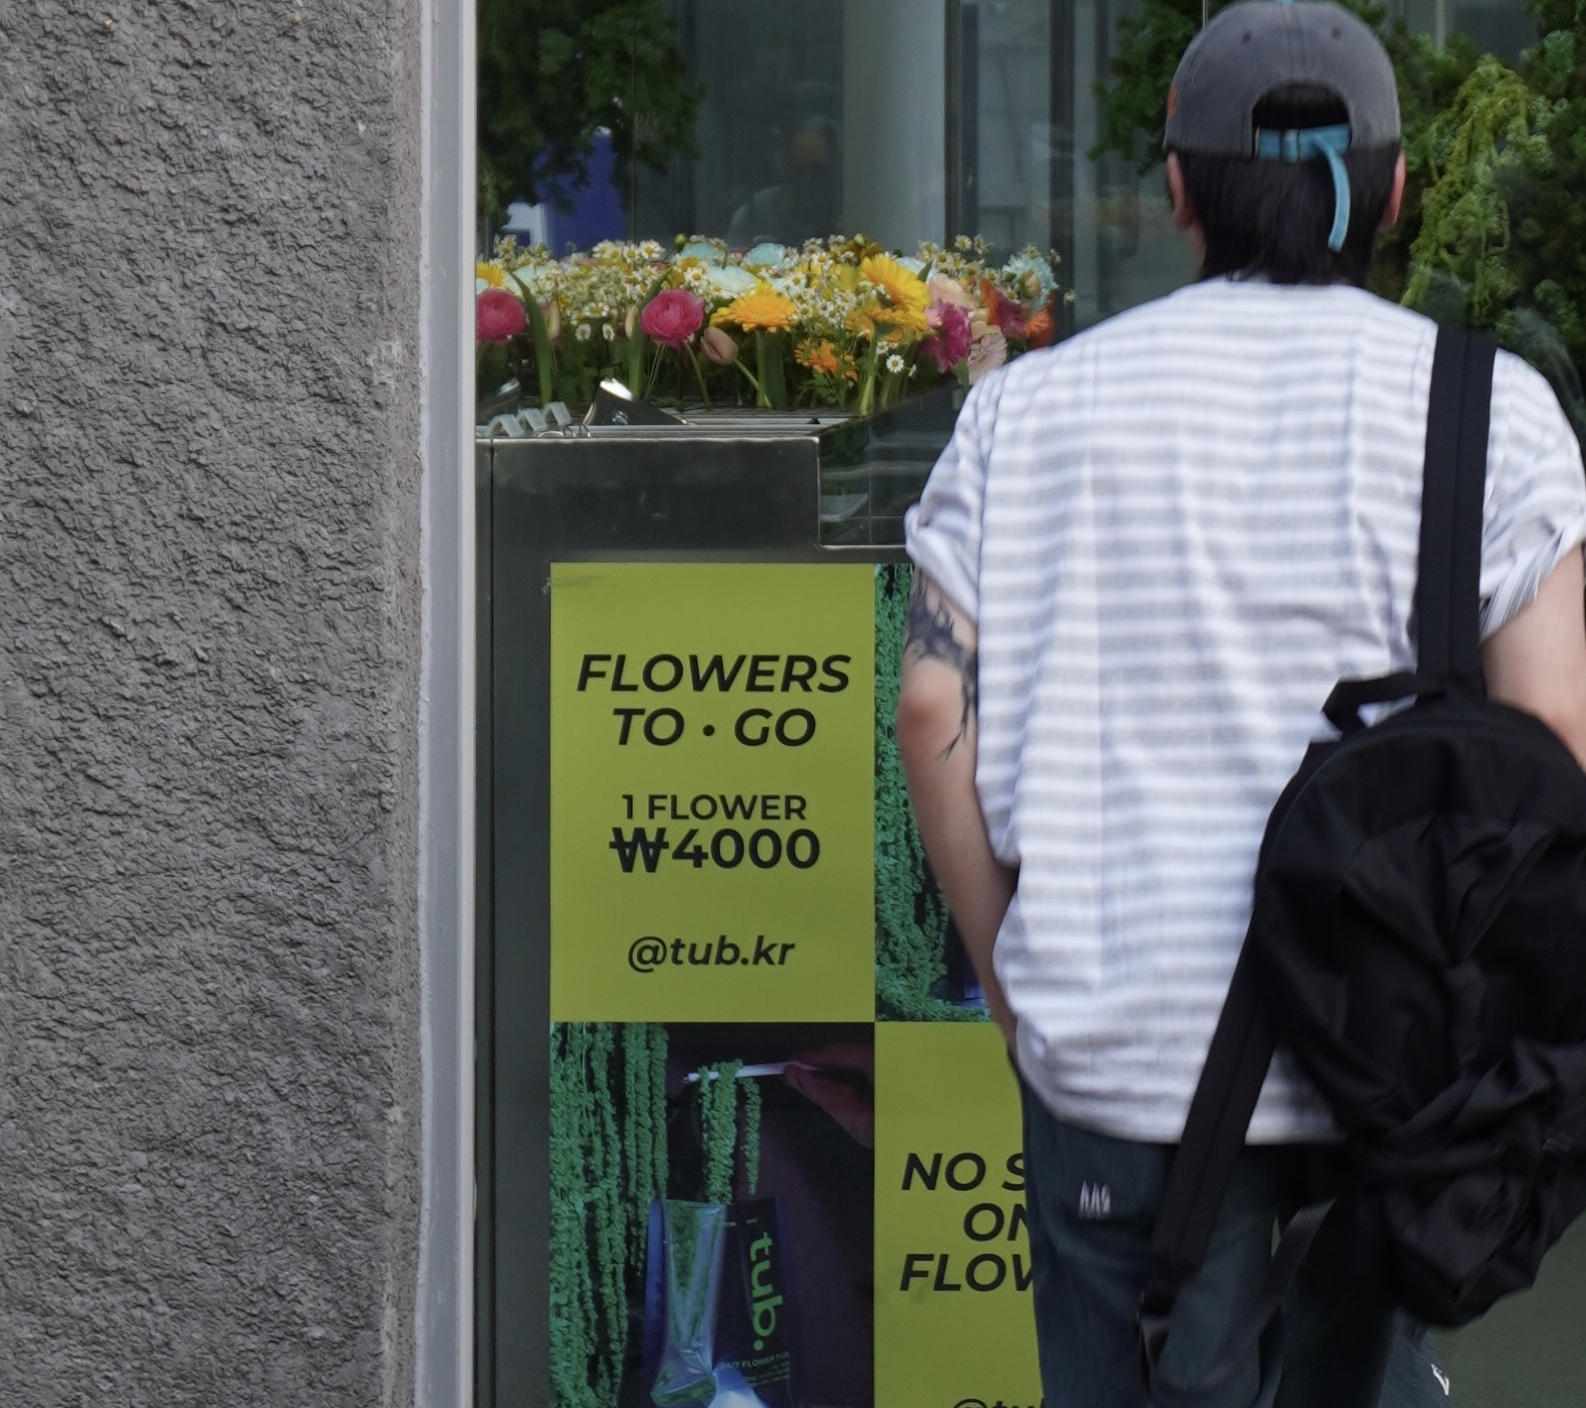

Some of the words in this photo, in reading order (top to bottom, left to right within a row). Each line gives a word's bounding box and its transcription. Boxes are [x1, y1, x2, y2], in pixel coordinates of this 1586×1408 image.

[575, 653, 853, 694] FLOWERS
[611, 706, 686, 748] TO
[733, 706, 818, 748] GO
[620, 793, 635, 821] 1
[647, 793, 808, 822] FLOWER
[608, 826, 821, 874] ₩4000
[627, 933, 797, 975] @tub.kr
[900, 1151, 988, 1193] NO
[749, 1230, 784, 1352] tub.
